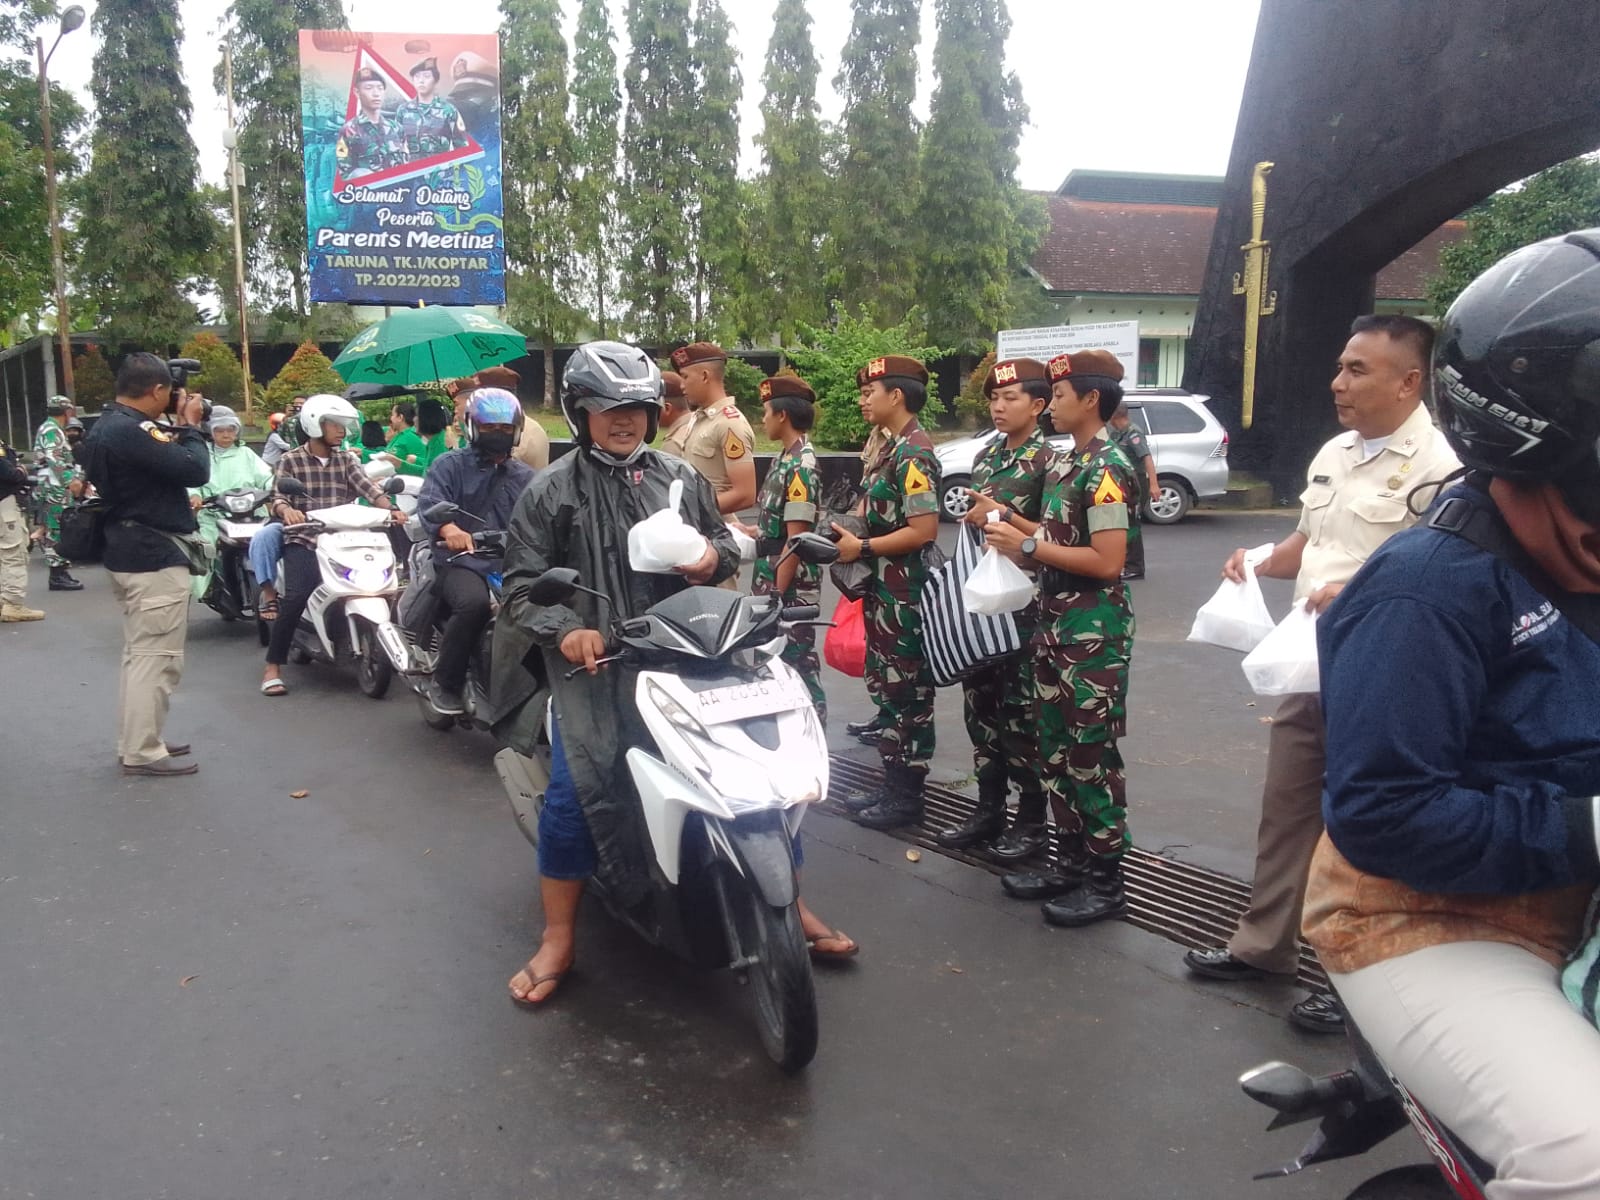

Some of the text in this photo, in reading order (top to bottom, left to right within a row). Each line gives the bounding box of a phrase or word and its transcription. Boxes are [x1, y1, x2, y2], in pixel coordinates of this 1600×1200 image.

[339, 185, 471, 210] Selamat Datang
[376, 208, 435, 226] Peserta
[317, 229, 495, 249] Parents Meeting
[326, 255, 388, 268] TARUNA
[355, 273, 460, 287] TP.2022/2023
[689, 613, 720, 623] HONDA
[699, 689, 721, 706] AA
